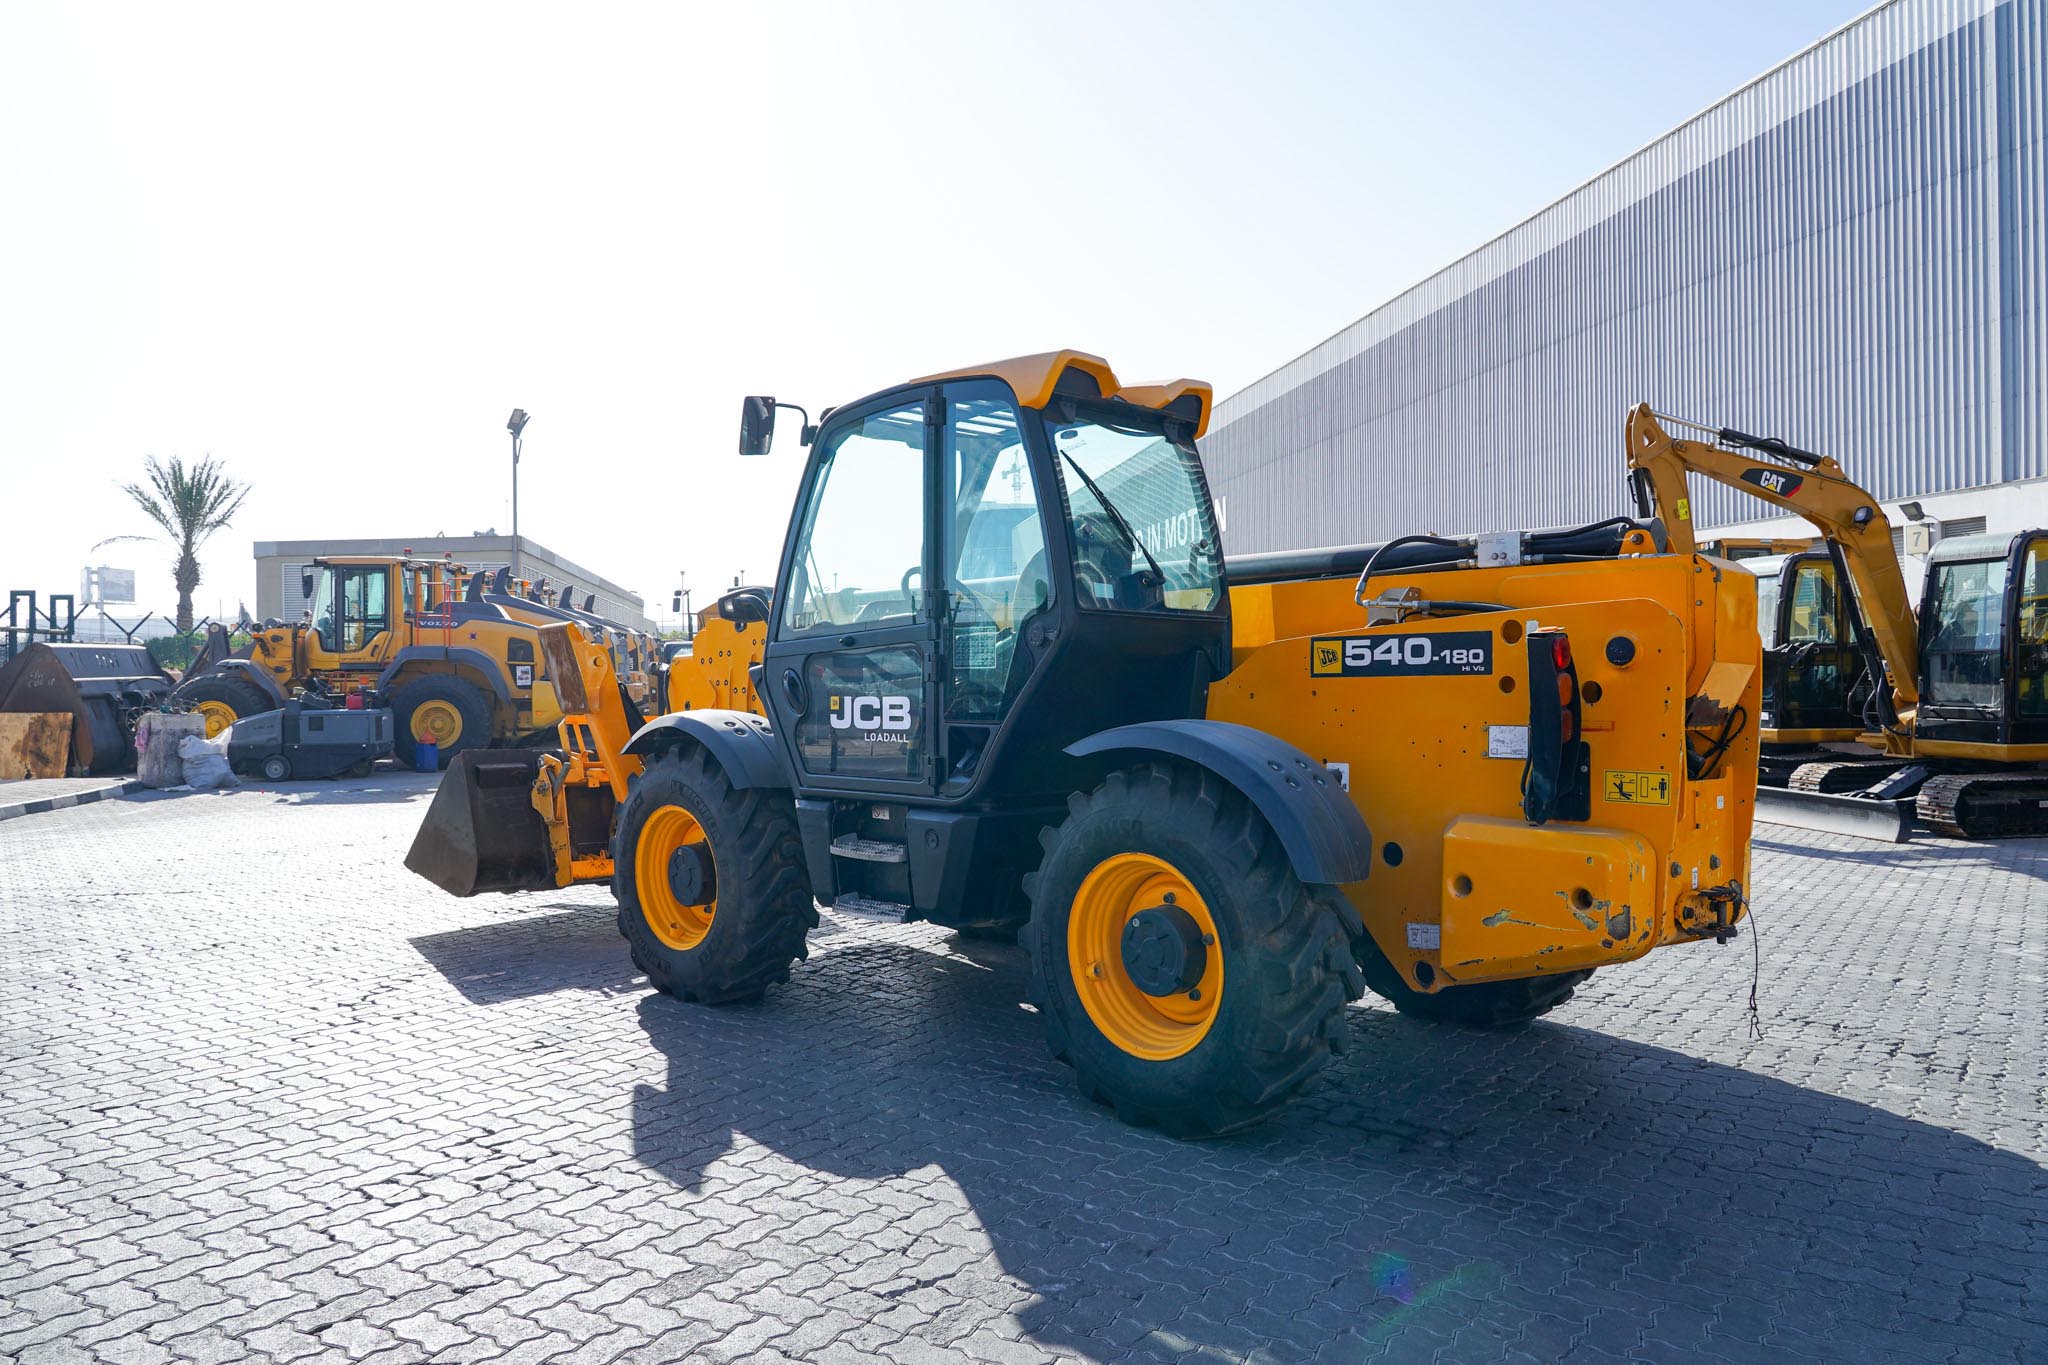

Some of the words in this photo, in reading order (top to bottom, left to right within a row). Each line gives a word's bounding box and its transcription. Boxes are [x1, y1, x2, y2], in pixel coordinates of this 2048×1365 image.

[1760, 470, 1786, 493] CAT
[1147, 522, 1161, 555] IN
[1913, 531, 1922, 547] 7
[1319, 648, 1338, 667] JCB
[1344, 637, 1484, 667] 540-180
[830, 695, 912, 730] JCB
[864, 732, 909, 743] LOADALL
